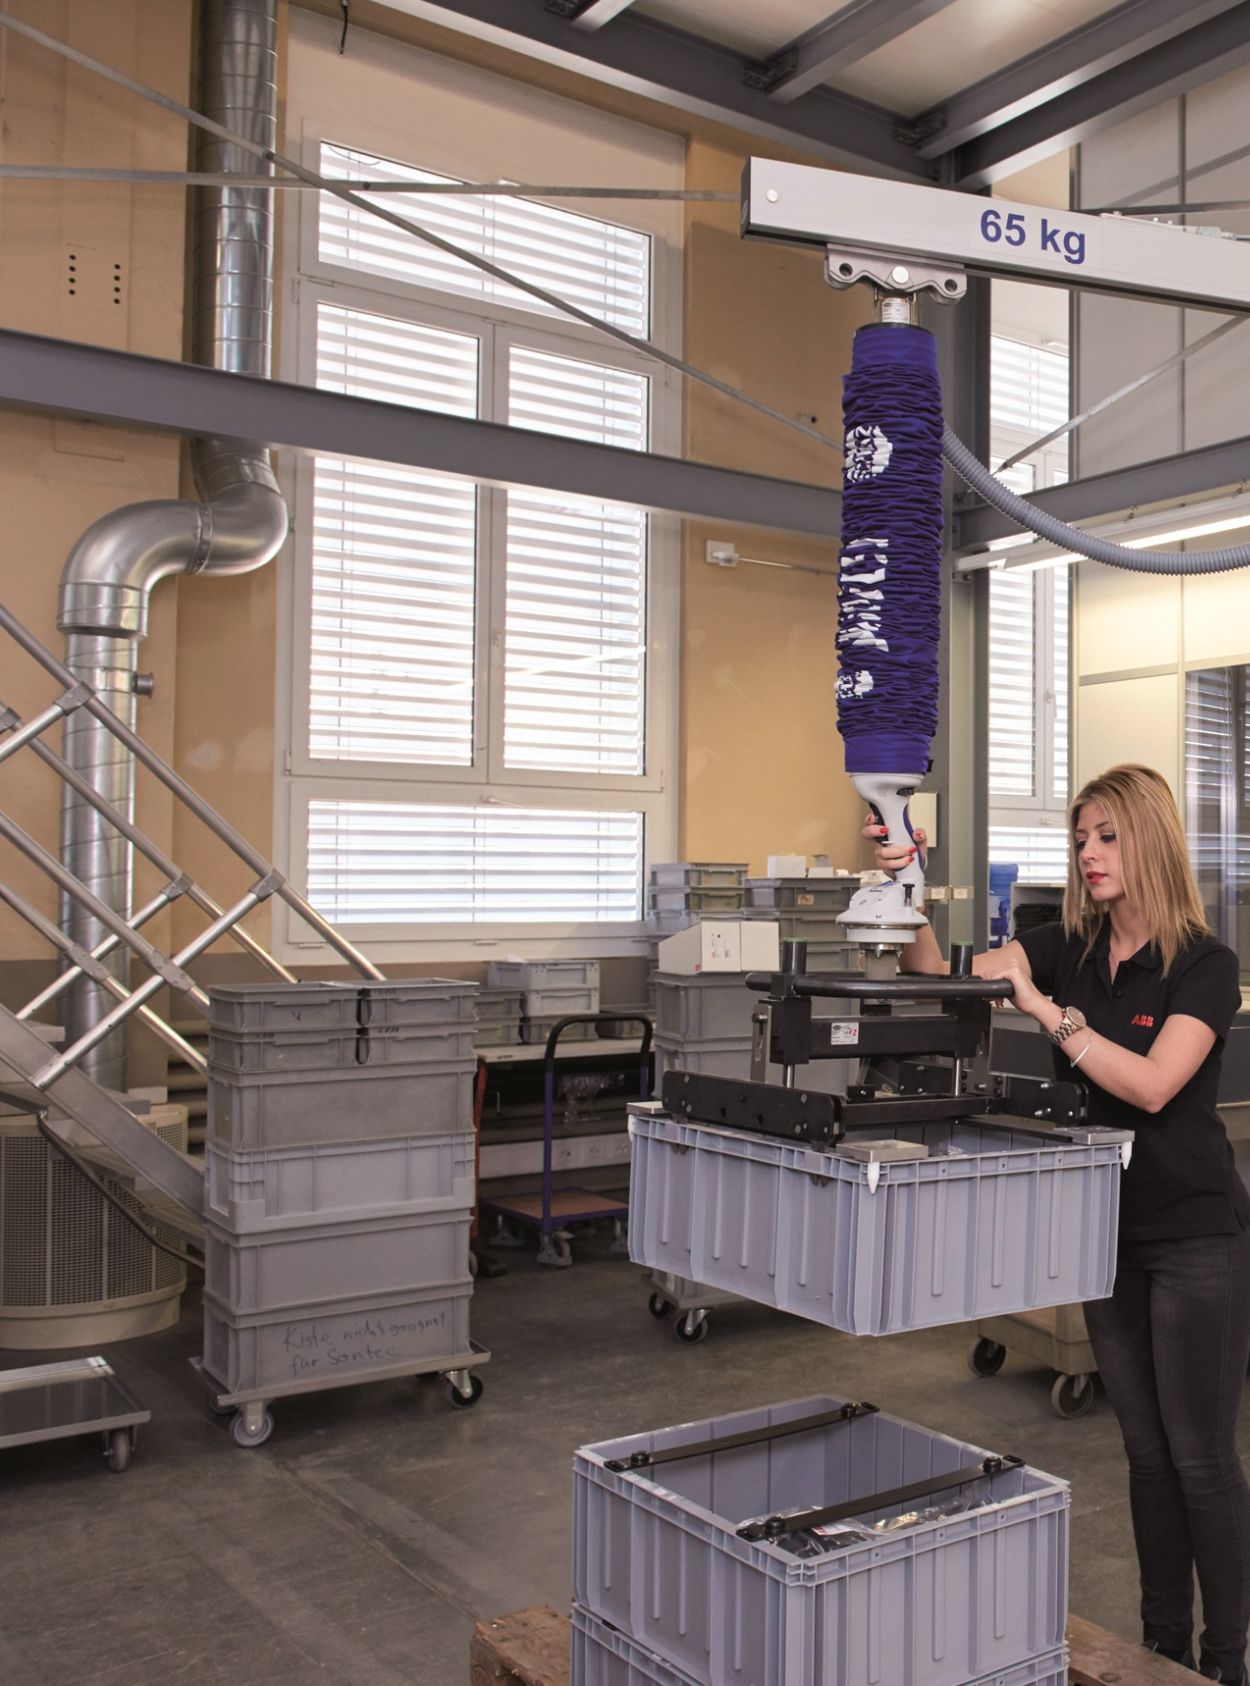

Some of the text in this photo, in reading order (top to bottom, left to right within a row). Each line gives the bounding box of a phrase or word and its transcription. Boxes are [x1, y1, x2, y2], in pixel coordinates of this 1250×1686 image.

[980, 209, 1085, 265] 65 kg
[1131, 1014, 1154, 1028] ABB
